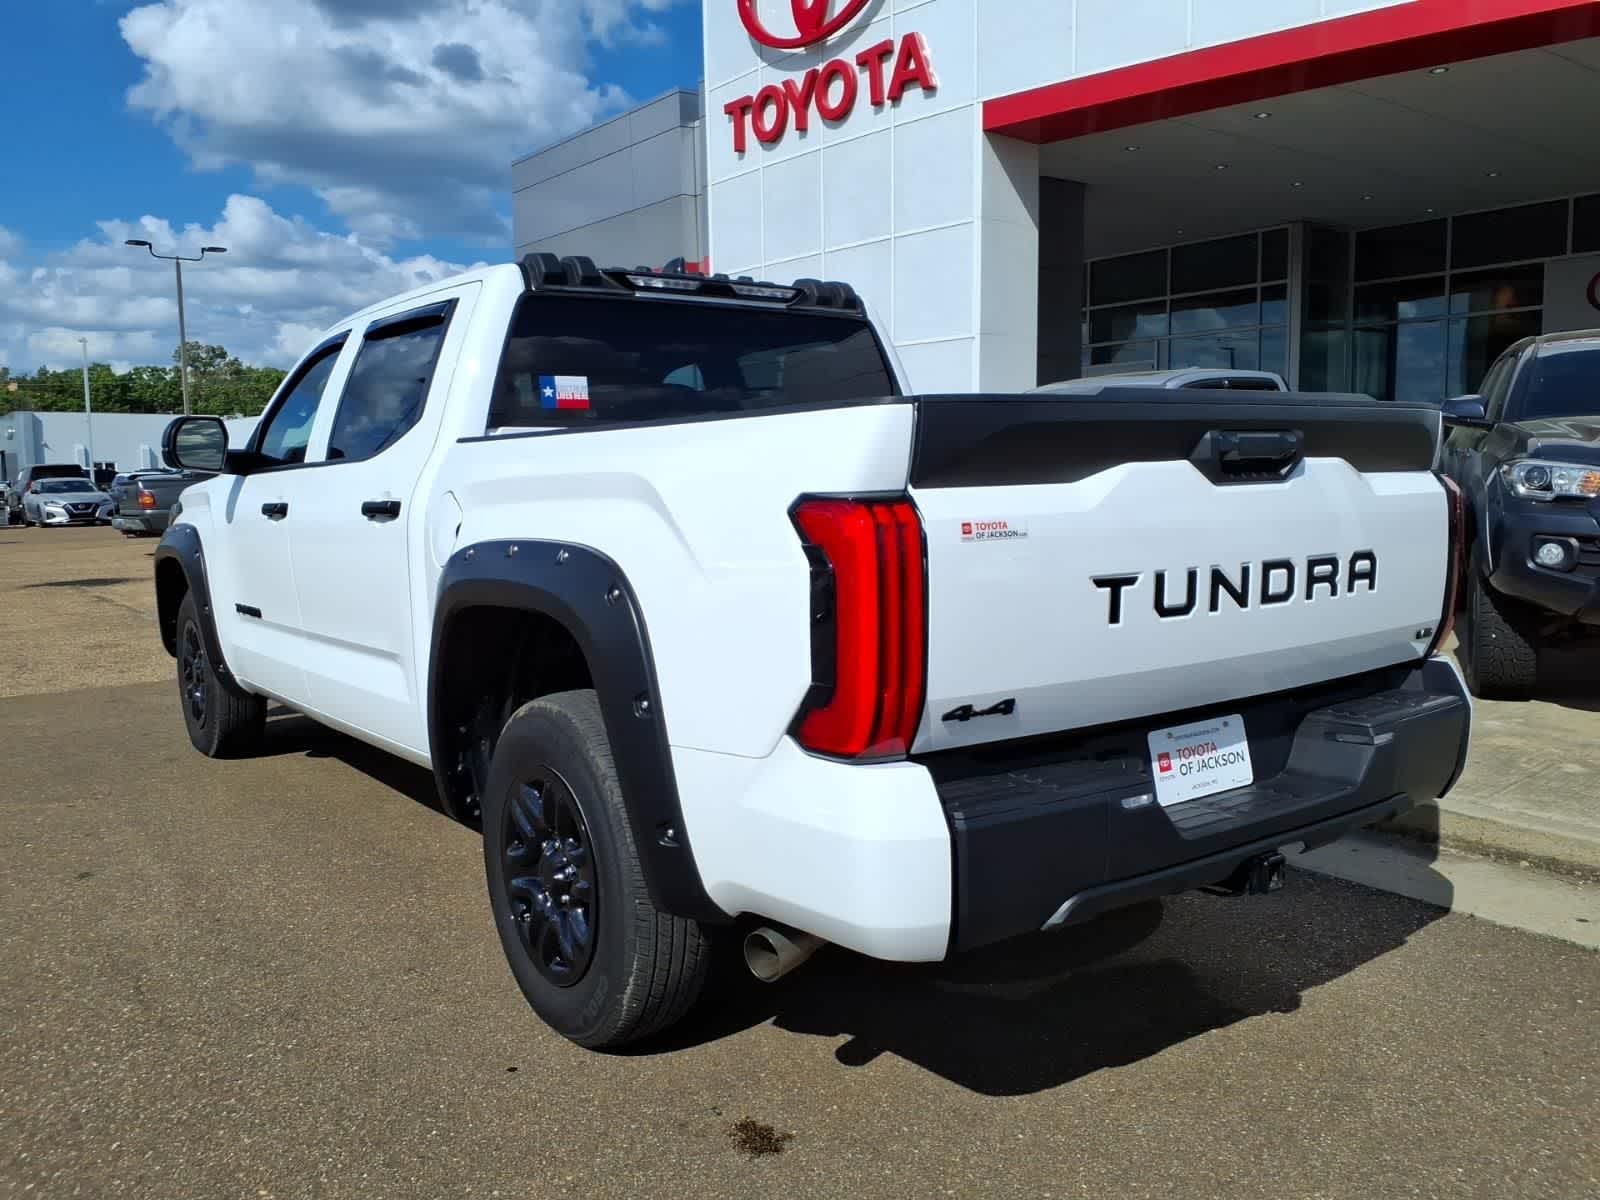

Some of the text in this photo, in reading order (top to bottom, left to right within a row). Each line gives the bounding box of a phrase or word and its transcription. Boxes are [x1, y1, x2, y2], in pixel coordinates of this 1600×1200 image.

[724, 32, 937, 152] TOYOTA
[975, 522, 1008, 531] TOYOTA
[976, 531, 986, 540] OF
[1090, 549, 1377, 626] TUNDRA
[1176, 742, 1217, 761] TOYOTA
[1179, 751, 1245, 776] OF JACKSON
